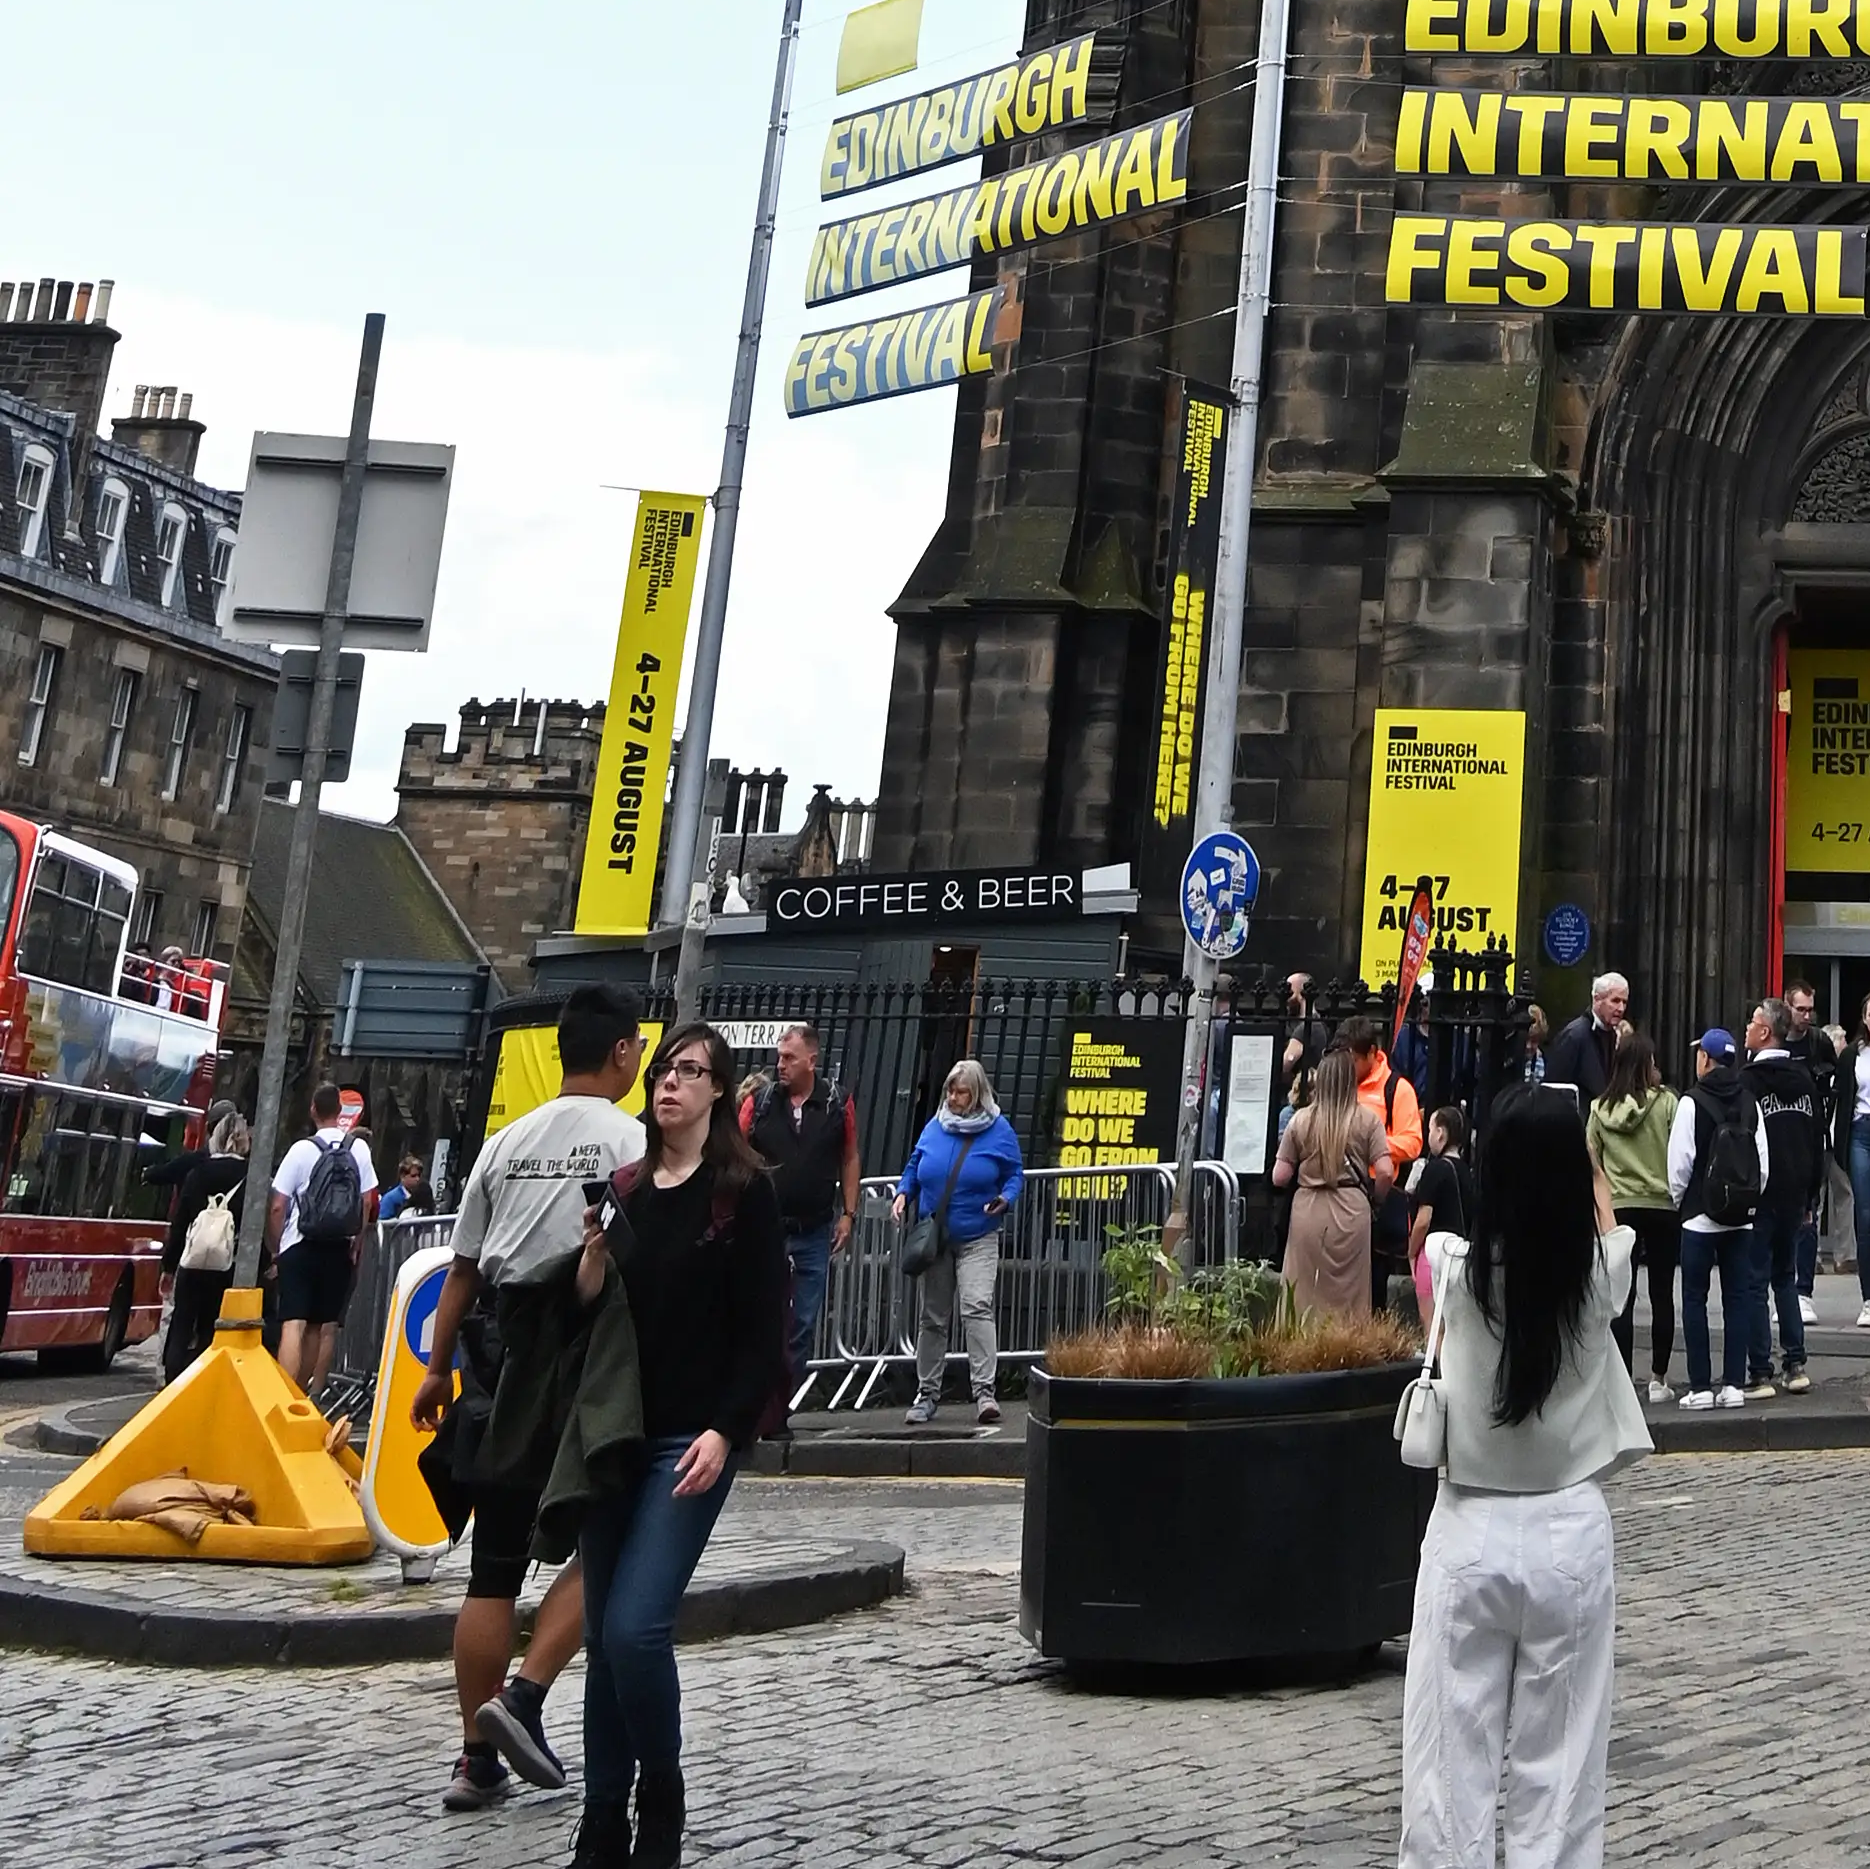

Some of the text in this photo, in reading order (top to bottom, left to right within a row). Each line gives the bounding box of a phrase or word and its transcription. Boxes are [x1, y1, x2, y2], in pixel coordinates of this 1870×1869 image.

[824, 39, 1095, 195] EDINBURGH
[807, 117, 1189, 304] INTERNATIONAL
[1386, 217, 1866, 315] FESTIVAL
[785, 292, 994, 413] FESTIVAL
[1182, 400, 1198, 473] FESTIVAL
[1187, 402, 1206, 528] INTERNATIONAL
[1198, 404, 1214, 499] EDINBURGH
[637, 508, 658, 570] FESTIVAL
[644, 509, 670, 615] INTERNATIONAL
[660, 510, 682, 589] EDINBURGH
[1153, 573, 1190, 827] GO FROM HERE?
[1171, 589, 1206, 815] WHERE DO WE
[1386, 759, 1508, 775] INTERNATIONAL
[1388, 742, 1477, 758] EDINBURGH
[606, 741, 649, 875] AUGUST
[1386, 775, 1456, 790] FESTIVAL
[776, 874, 1074, 920] COFFEE & BEER
[1380, 875, 1450, 900] 4–7
[1070, 1067, 1112, 1078] FESTIVAL
[1071, 1056, 1141, 1067] INTERNATIONAL
[1073, 1044, 1124, 1055] EDINBURGH
[1062, 1117, 1135, 1144] DO WE
[1066, 1089, 1147, 1116] WHERE
[507, 1157, 599, 1172] TRAVEL THE WORLD
[1060, 1145, 1159, 1168] GO FROM
